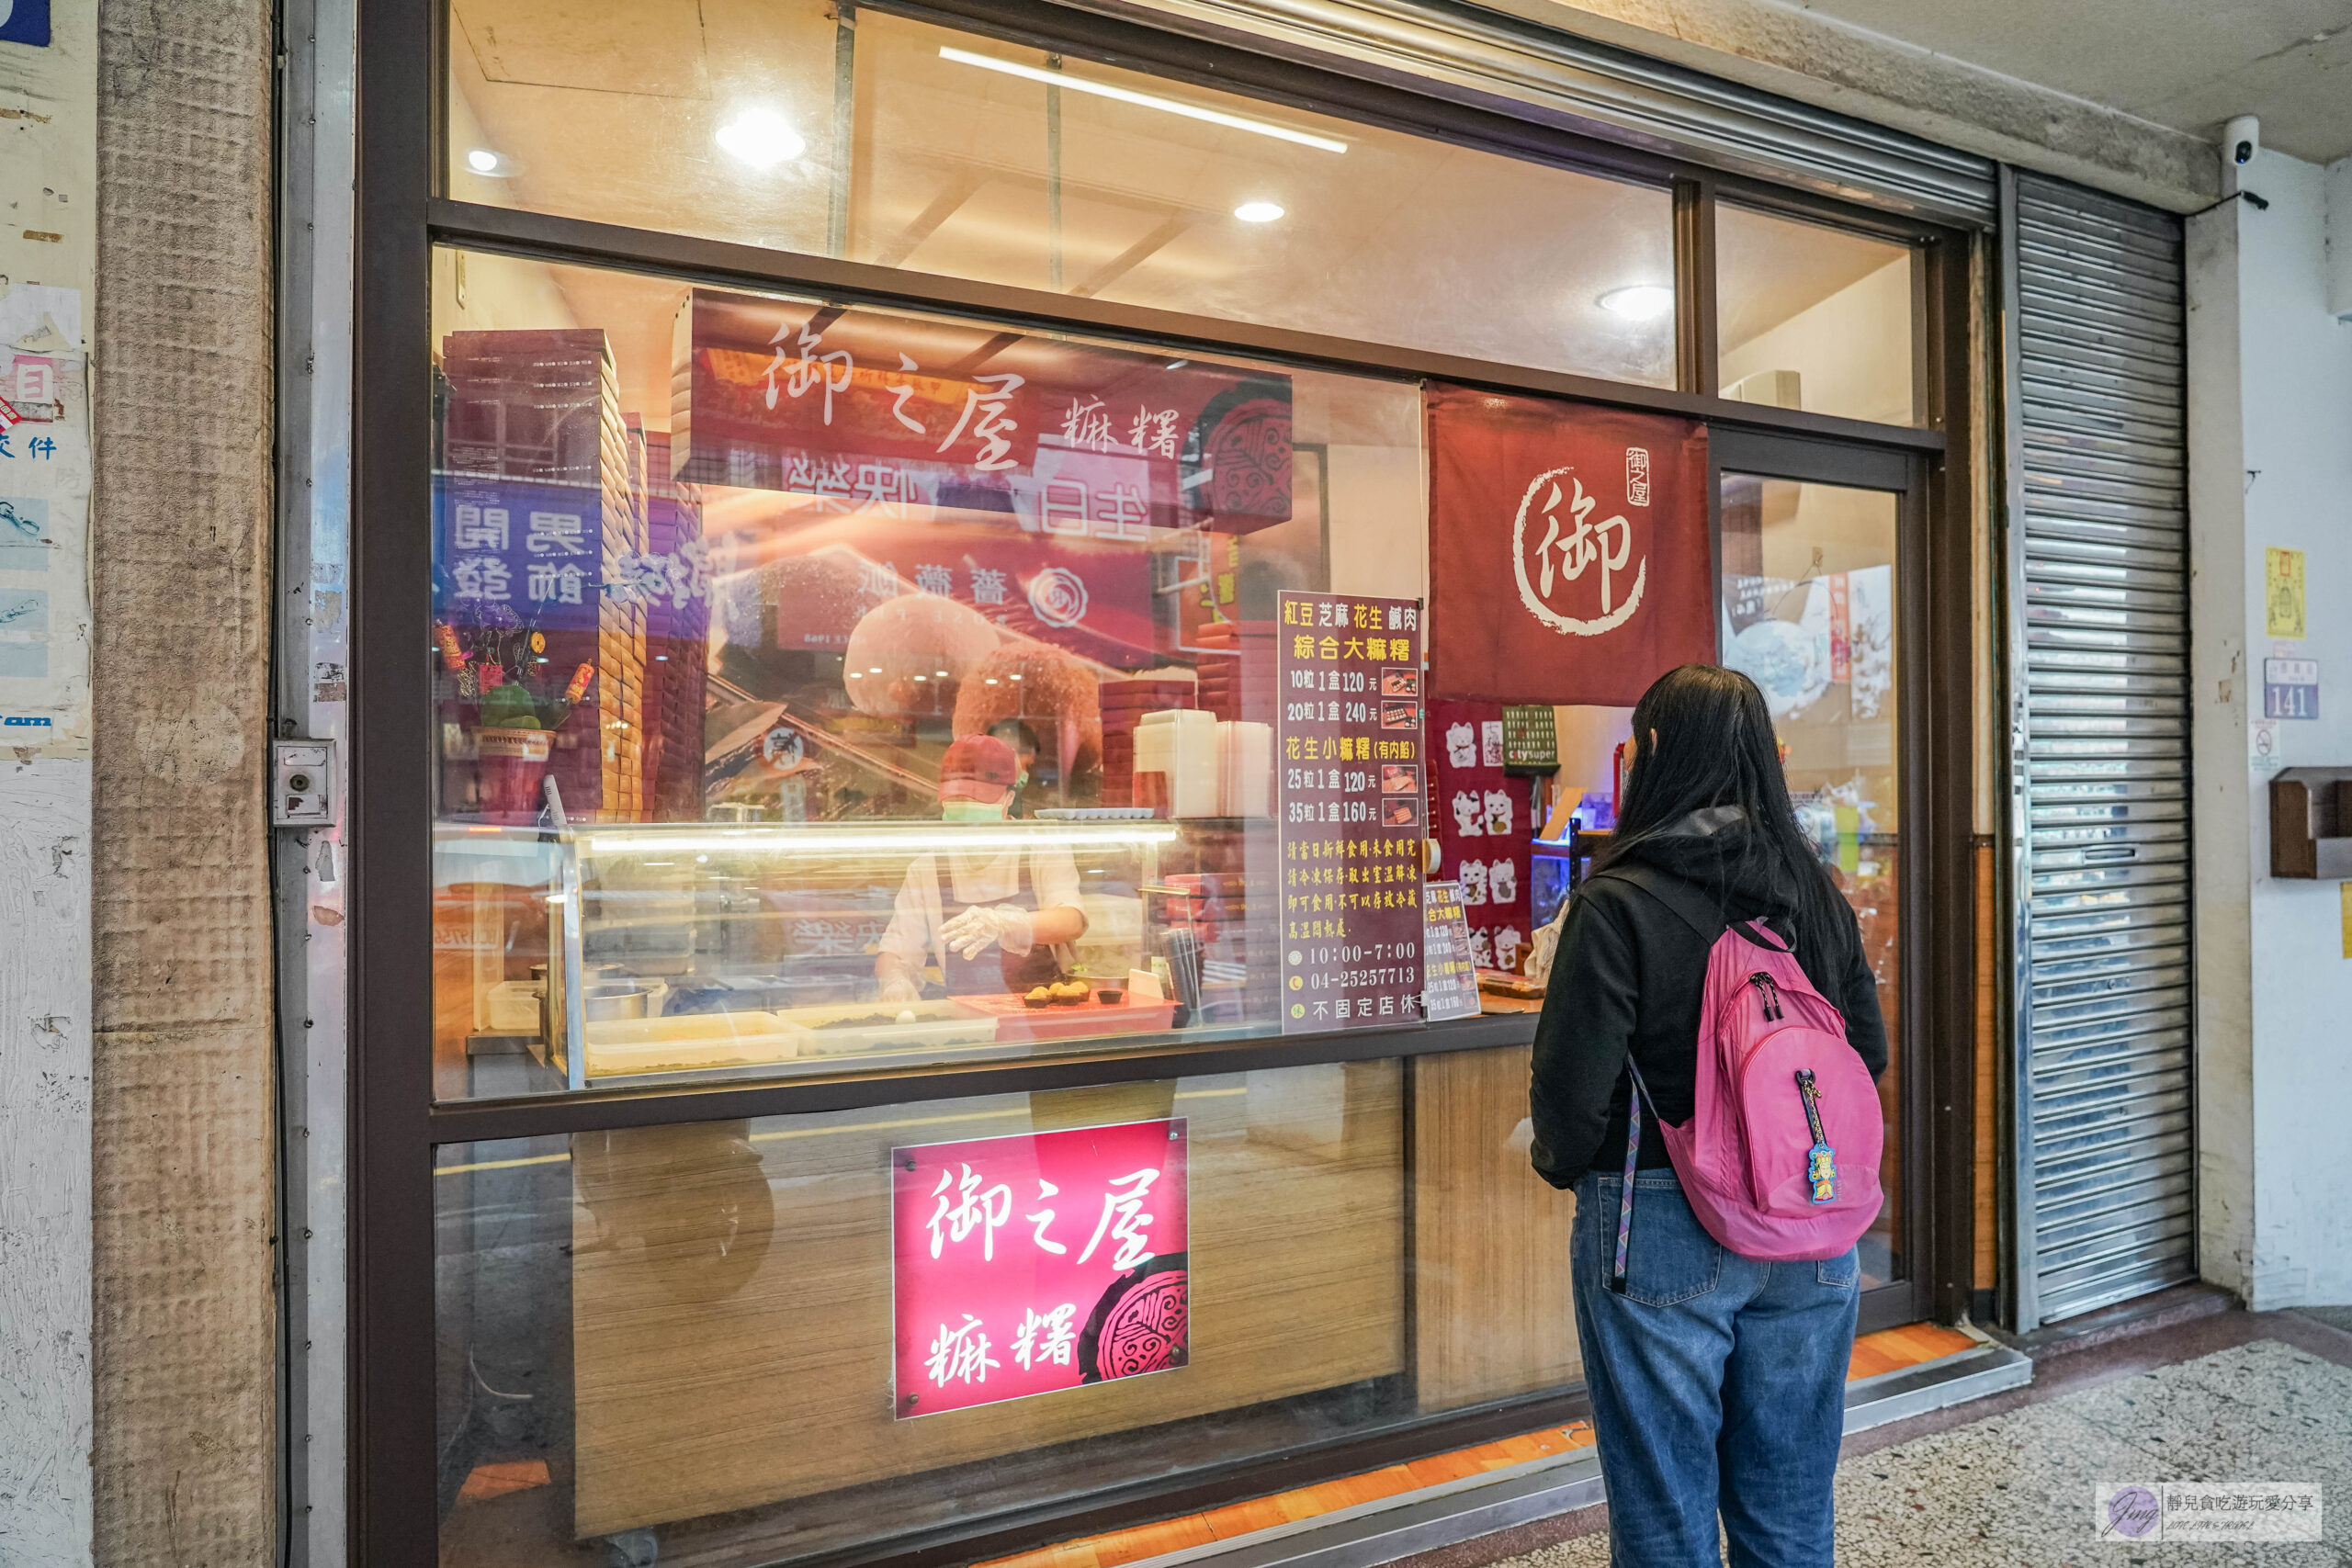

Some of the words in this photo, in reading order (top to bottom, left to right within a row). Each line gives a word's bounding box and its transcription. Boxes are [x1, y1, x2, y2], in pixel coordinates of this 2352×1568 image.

[762, 322, 1026, 470] 御之屋
[1628, 449, 1647, 503] 御之屋
[1534, 477, 1632, 615] 御
[1283, 600, 1314, 626] 紅豆
[1318, 602, 1349, 628] 芝麻
[1353, 604, 1383, 630] 花生
[2271, 685, 2308, 716] 141
[1310, 942, 1416, 964] 10:00-7:00
[1310, 966, 1415, 990] 04-25257713
[1312, 993, 1416, 1021] 不固定店休
[925, 1162, 1161, 1271] 御之屋
